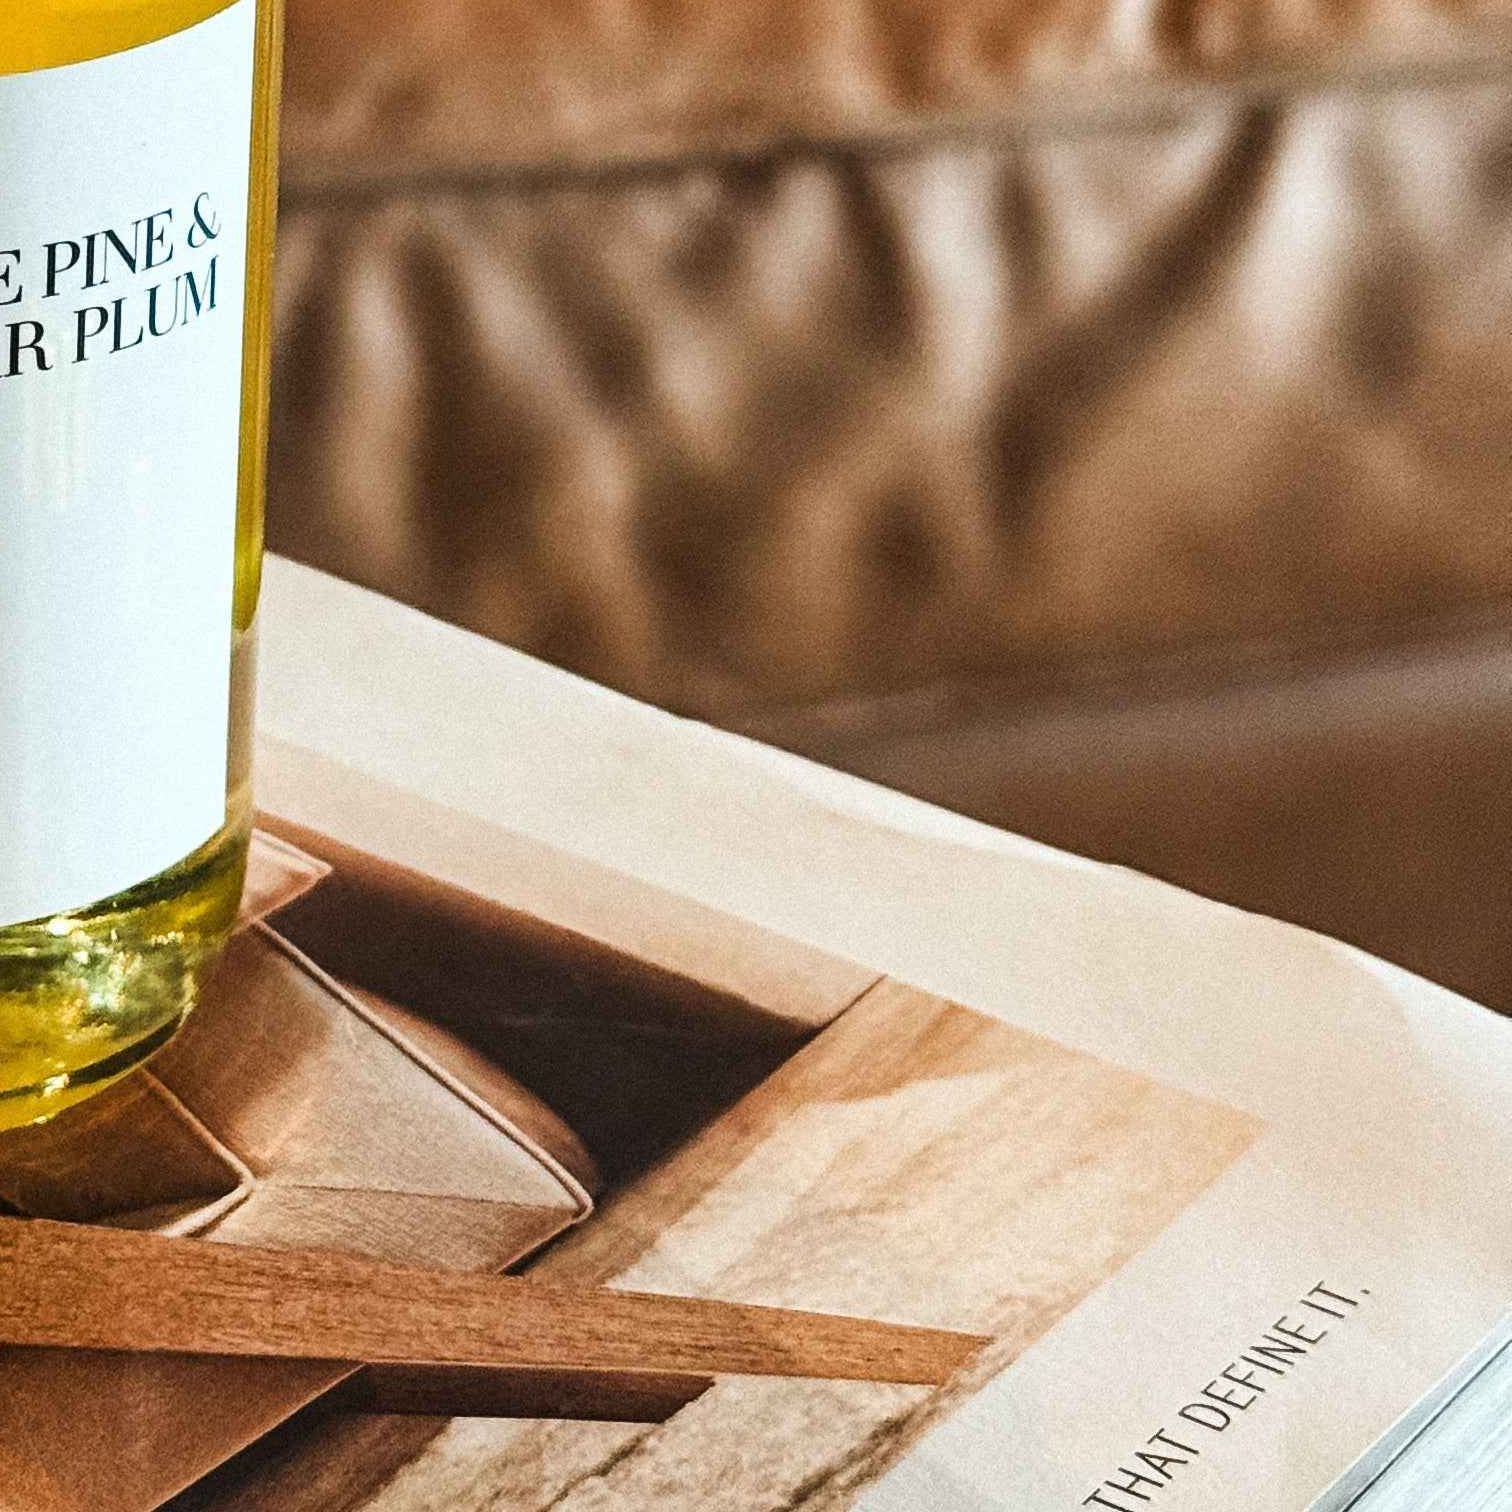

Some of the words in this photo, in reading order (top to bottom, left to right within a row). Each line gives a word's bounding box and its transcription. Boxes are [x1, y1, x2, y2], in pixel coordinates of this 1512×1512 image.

[42, 208, 173, 299] PINE
[187, 191, 221, 249] &
[72, 254, 218, 364] PLUM
[1083, 1428, 1199, 1512] THAT
[1178, 1317, 1326, 1432] DEFINE
[1301, 1281, 1370, 1318] IT.
